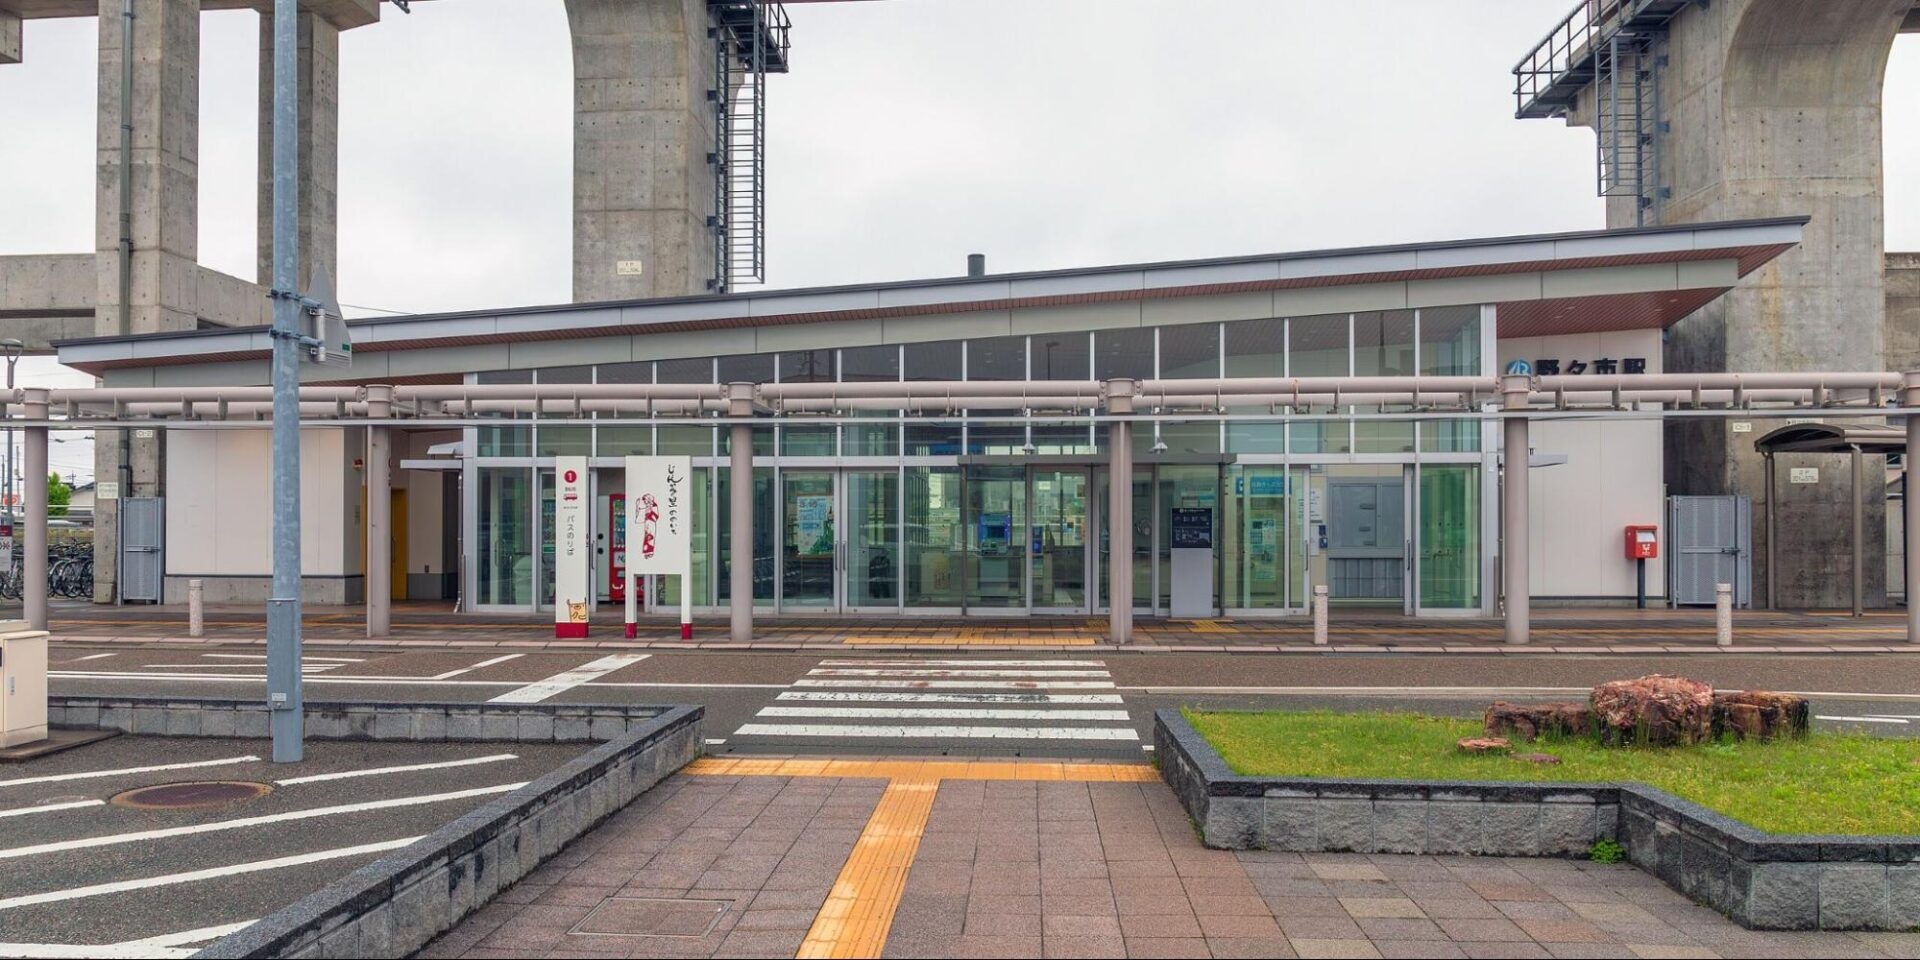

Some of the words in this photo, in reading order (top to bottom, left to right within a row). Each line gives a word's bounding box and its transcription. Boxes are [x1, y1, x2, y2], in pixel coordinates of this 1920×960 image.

[566, 515, 575, 556] バスのりば
